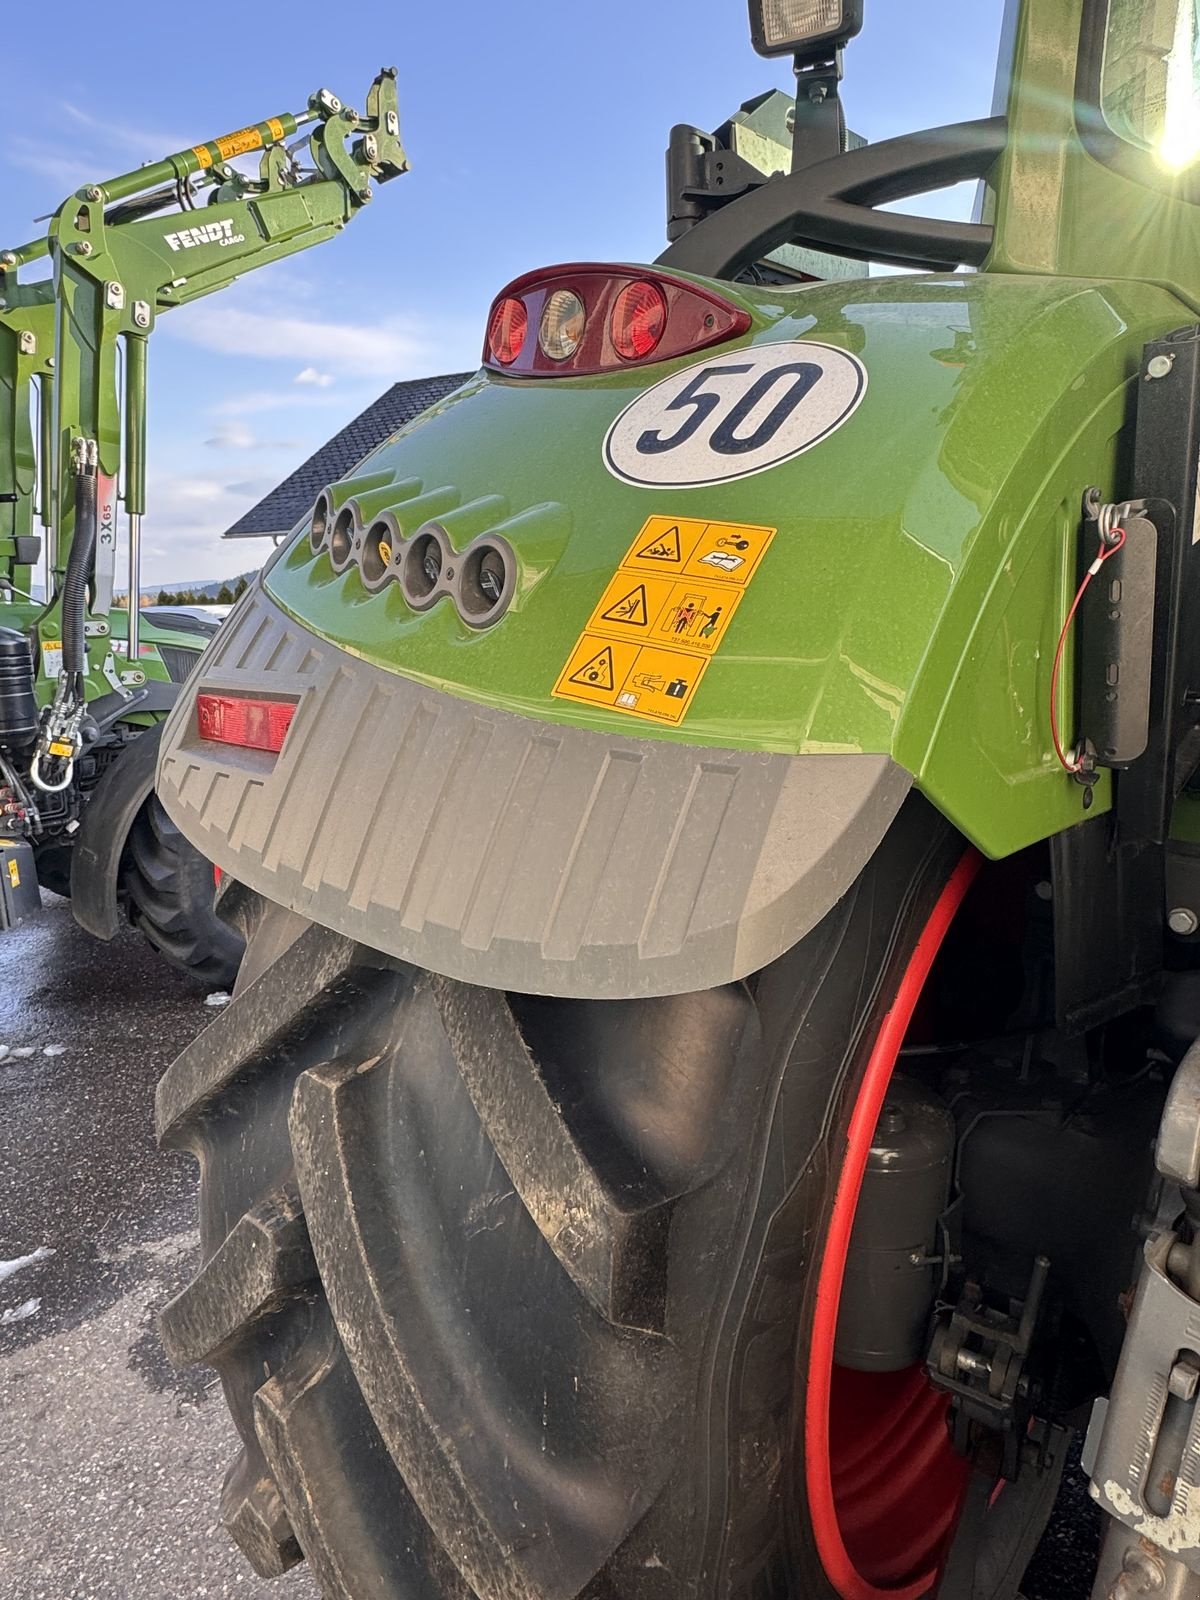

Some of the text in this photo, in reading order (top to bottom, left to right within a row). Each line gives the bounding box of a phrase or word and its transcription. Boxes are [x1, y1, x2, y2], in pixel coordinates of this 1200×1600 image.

[163, 218, 234, 252] FENDT
[219, 233, 246, 247] CARGO
[636, 362, 823, 454] 50
